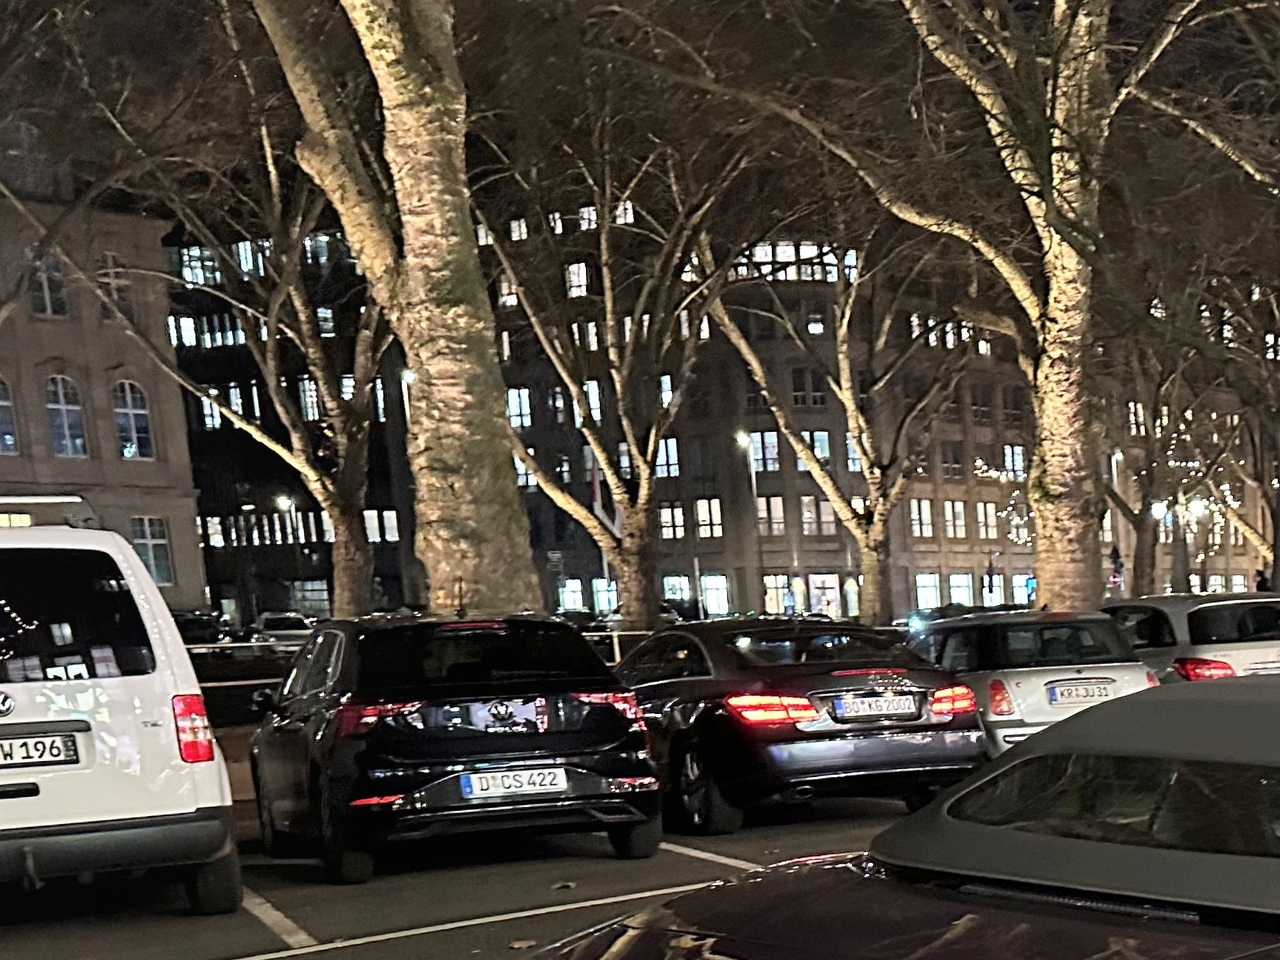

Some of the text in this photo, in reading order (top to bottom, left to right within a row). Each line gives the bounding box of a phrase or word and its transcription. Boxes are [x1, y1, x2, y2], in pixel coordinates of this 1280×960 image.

[19, 739, 63, 760] 196
[479, 771, 558, 792] D CS 422
